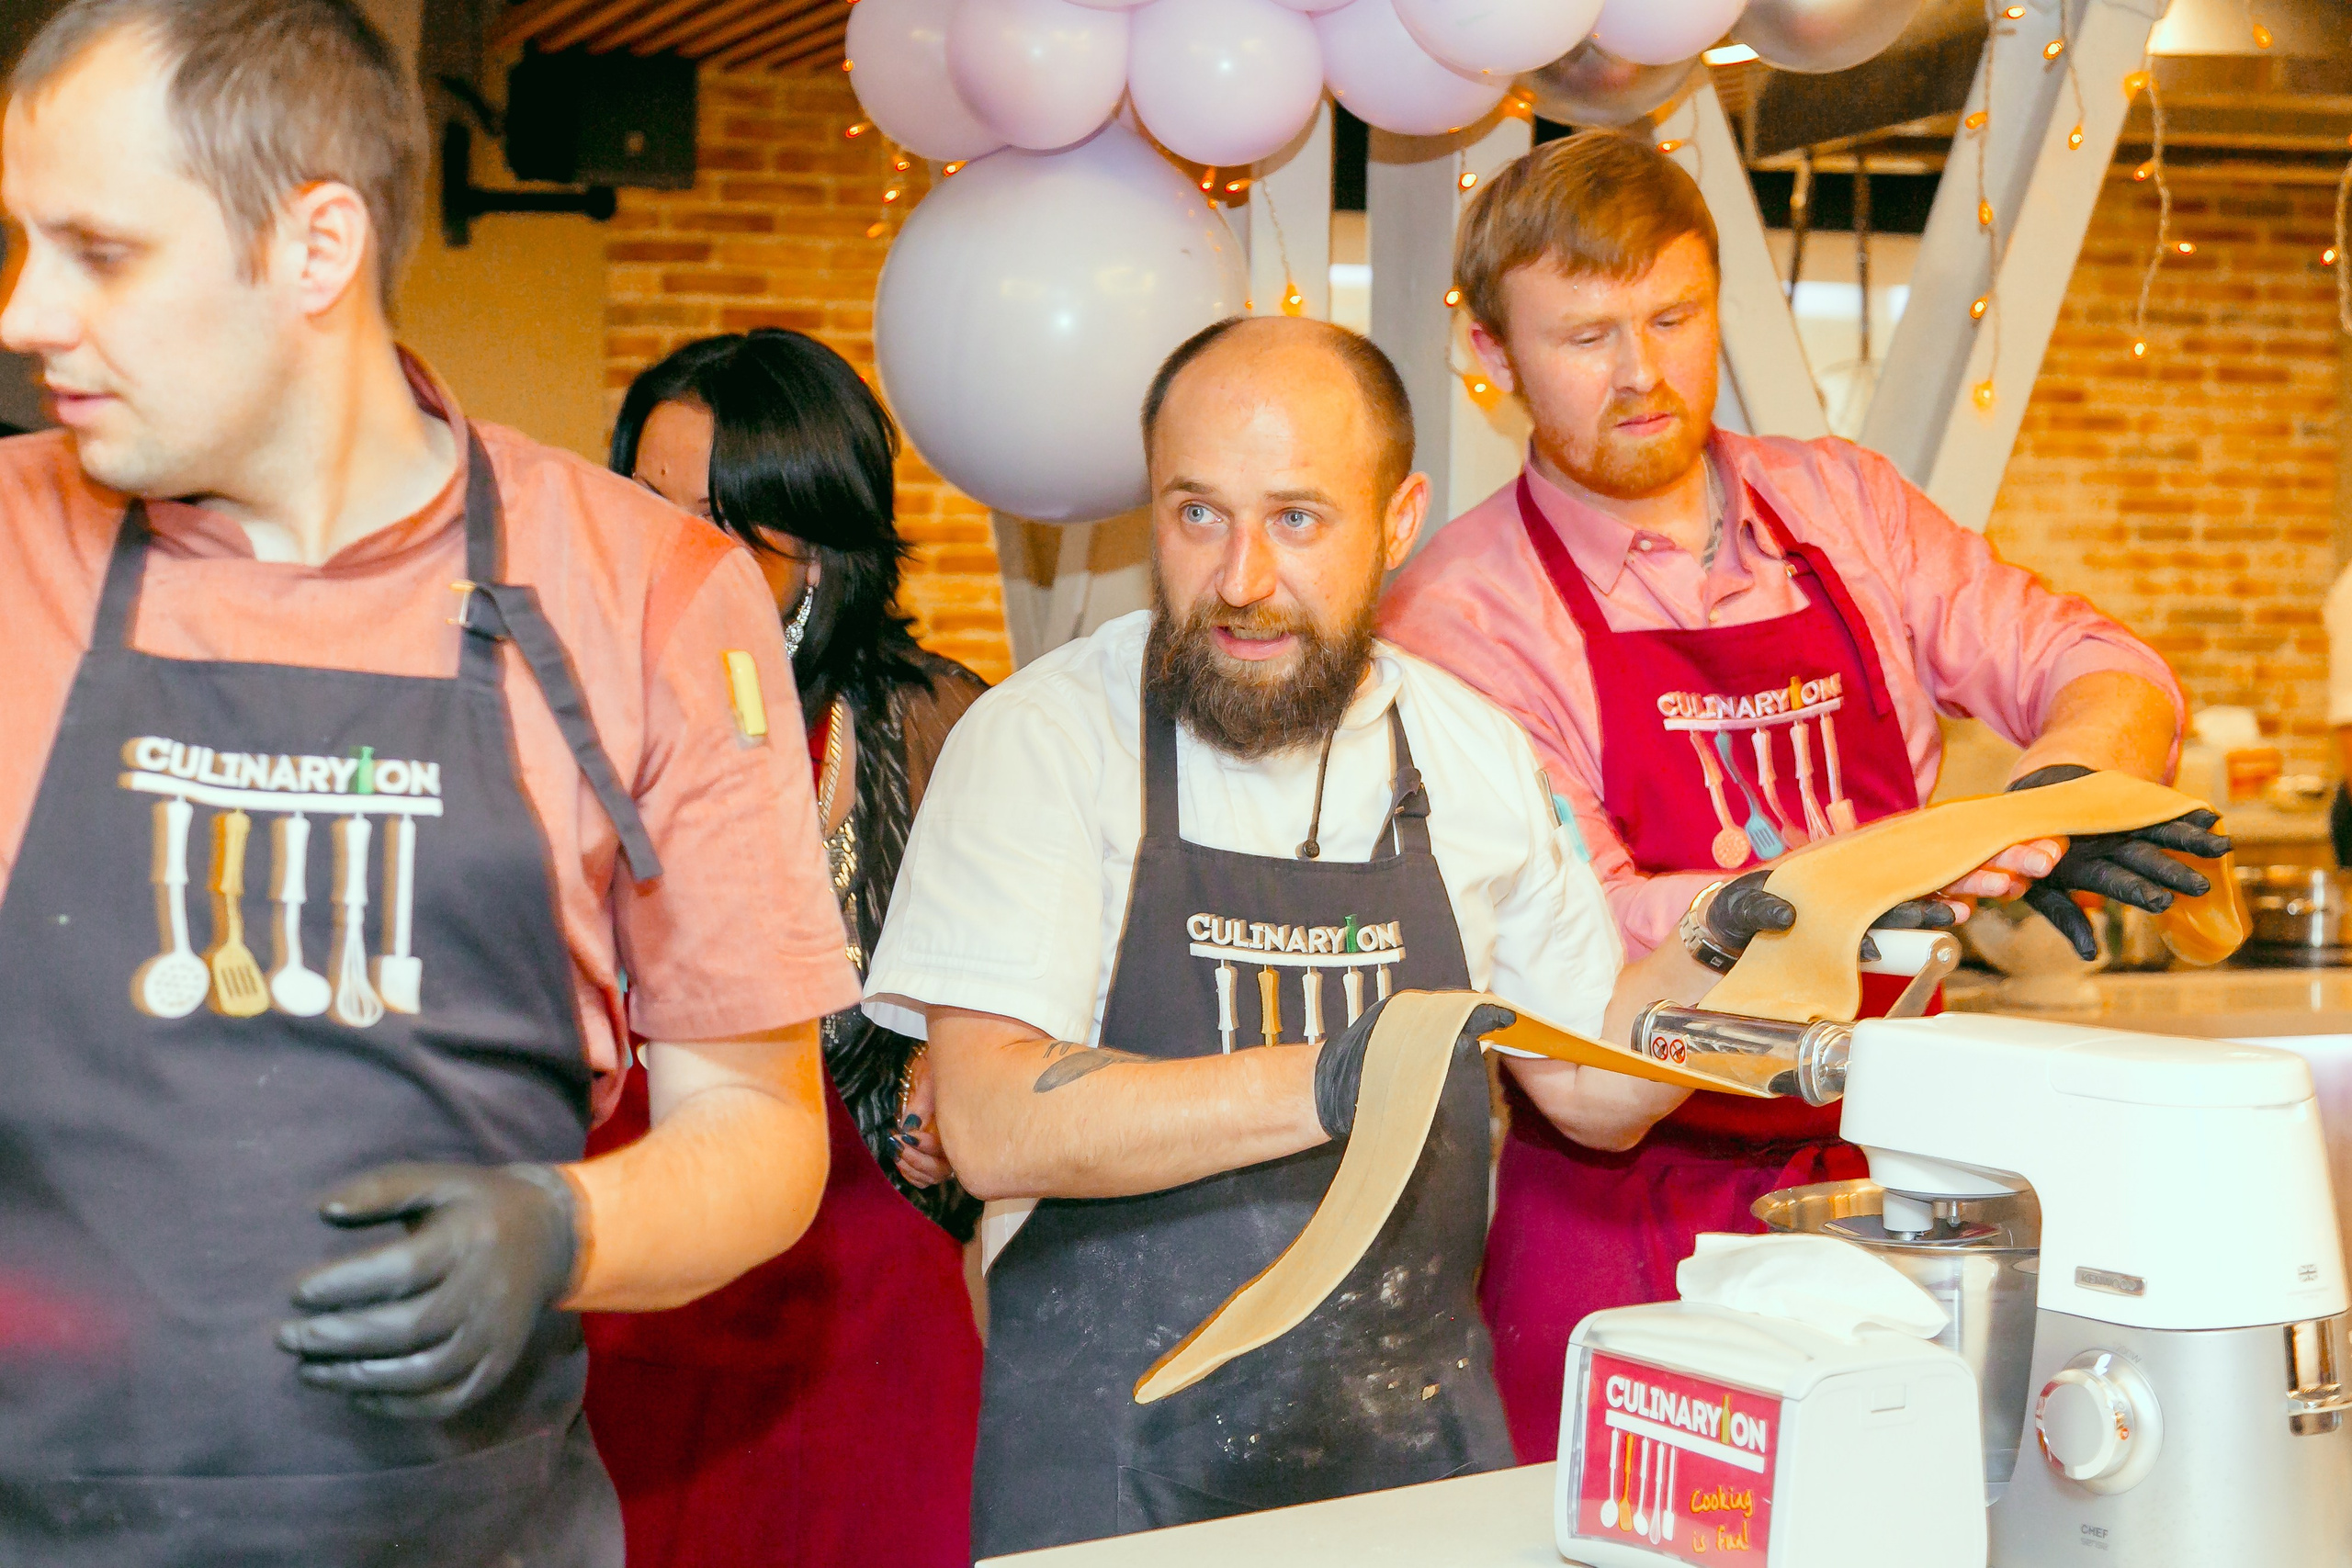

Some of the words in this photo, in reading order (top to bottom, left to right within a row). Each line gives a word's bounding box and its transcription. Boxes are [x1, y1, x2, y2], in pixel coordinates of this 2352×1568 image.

[1690, 1484, 1753, 1518] Cooking
[1692, 1530, 1706, 1553] is
[2080, 1524, 2109, 1539] CHEF
